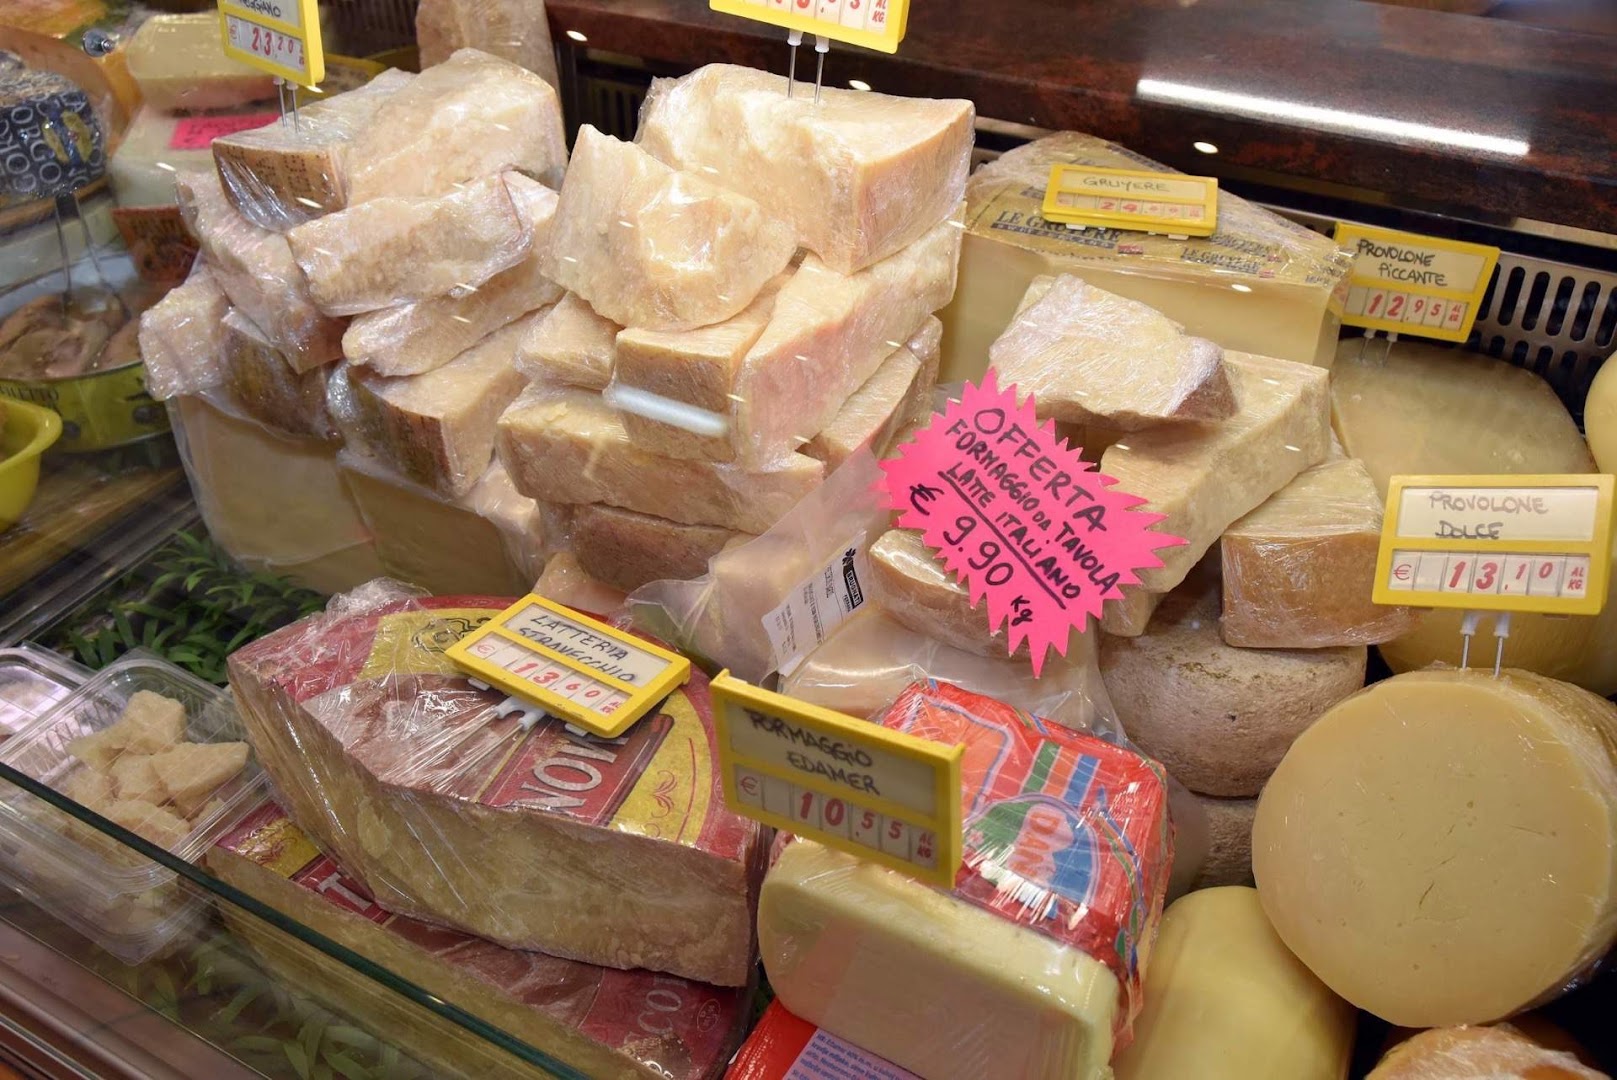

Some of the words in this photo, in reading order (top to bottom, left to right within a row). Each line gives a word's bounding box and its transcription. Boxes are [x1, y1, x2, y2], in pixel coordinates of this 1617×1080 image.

[1083, 176, 1170, 192] GRUYERE
[1357, 238, 1435, 267] PROVOLONE
[946, 462, 995, 509] LATTE
[974, 408, 1107, 531] OFFERTA
[945, 419, 1040, 512] FORMAGGIO
[1054, 521, 1120, 595] TAVOLA
[1429, 491, 1548, 514] PROVOLONE
[910, 483, 945, 516] €
[943, 516, 1014, 585] 9.90
[1434, 519, 1503, 540] DOLCE
[1393, 564, 1412, 581] €
[1570, 567, 1584, 578] AL
[518, 626, 636, 683] STRAVECCHIO
[530, 614, 629, 661] LATTERIA
[740, 776, 758, 796] €
[786, 751, 880, 795] EDAMER
